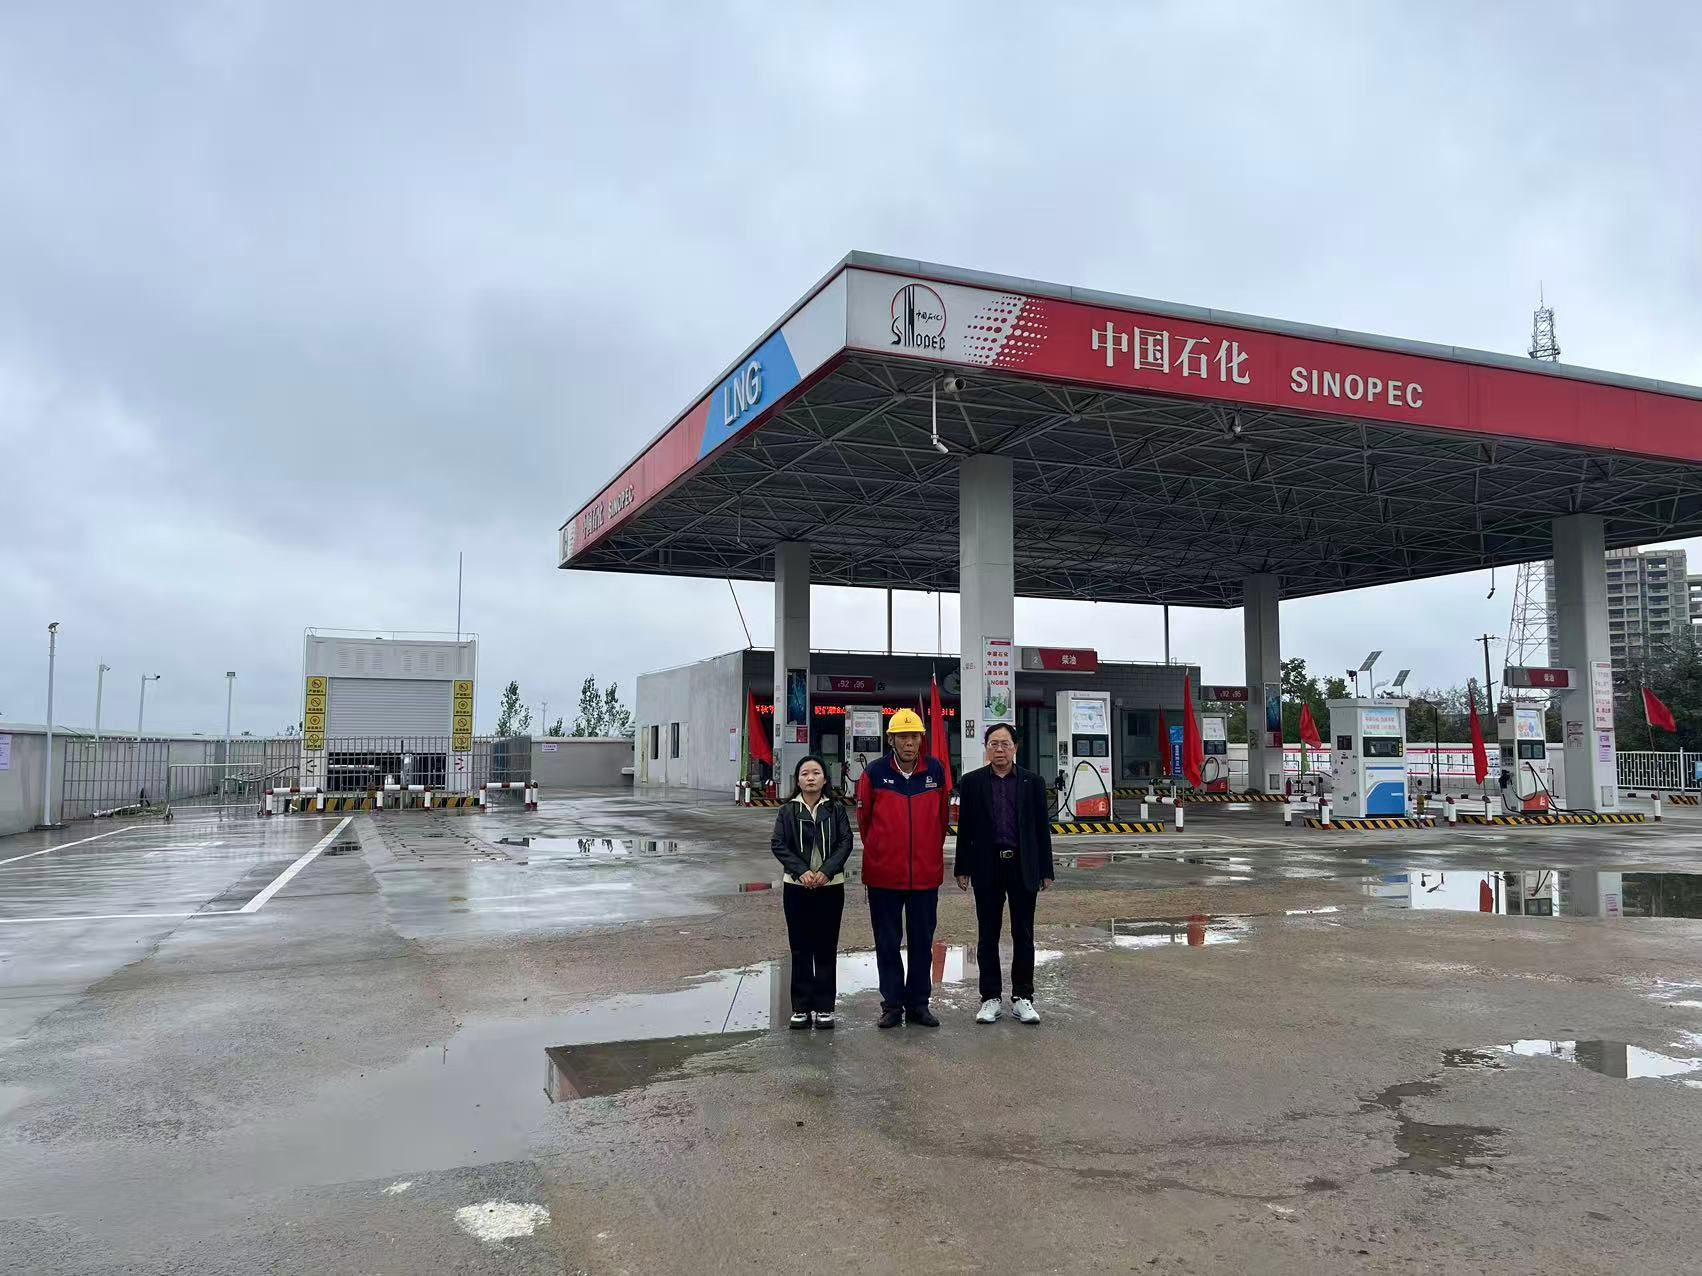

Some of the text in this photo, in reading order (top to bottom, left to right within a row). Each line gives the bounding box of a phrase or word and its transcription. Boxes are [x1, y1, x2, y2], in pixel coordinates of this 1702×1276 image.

[891, 284, 946, 350] SINOPEC
[1091, 321, 1251, 385] 中国石化
[723, 360, 763, 426] LNG
[1290, 366, 1424, 409] SINOPEC
[1061, 654, 1077, 665] 柴油
